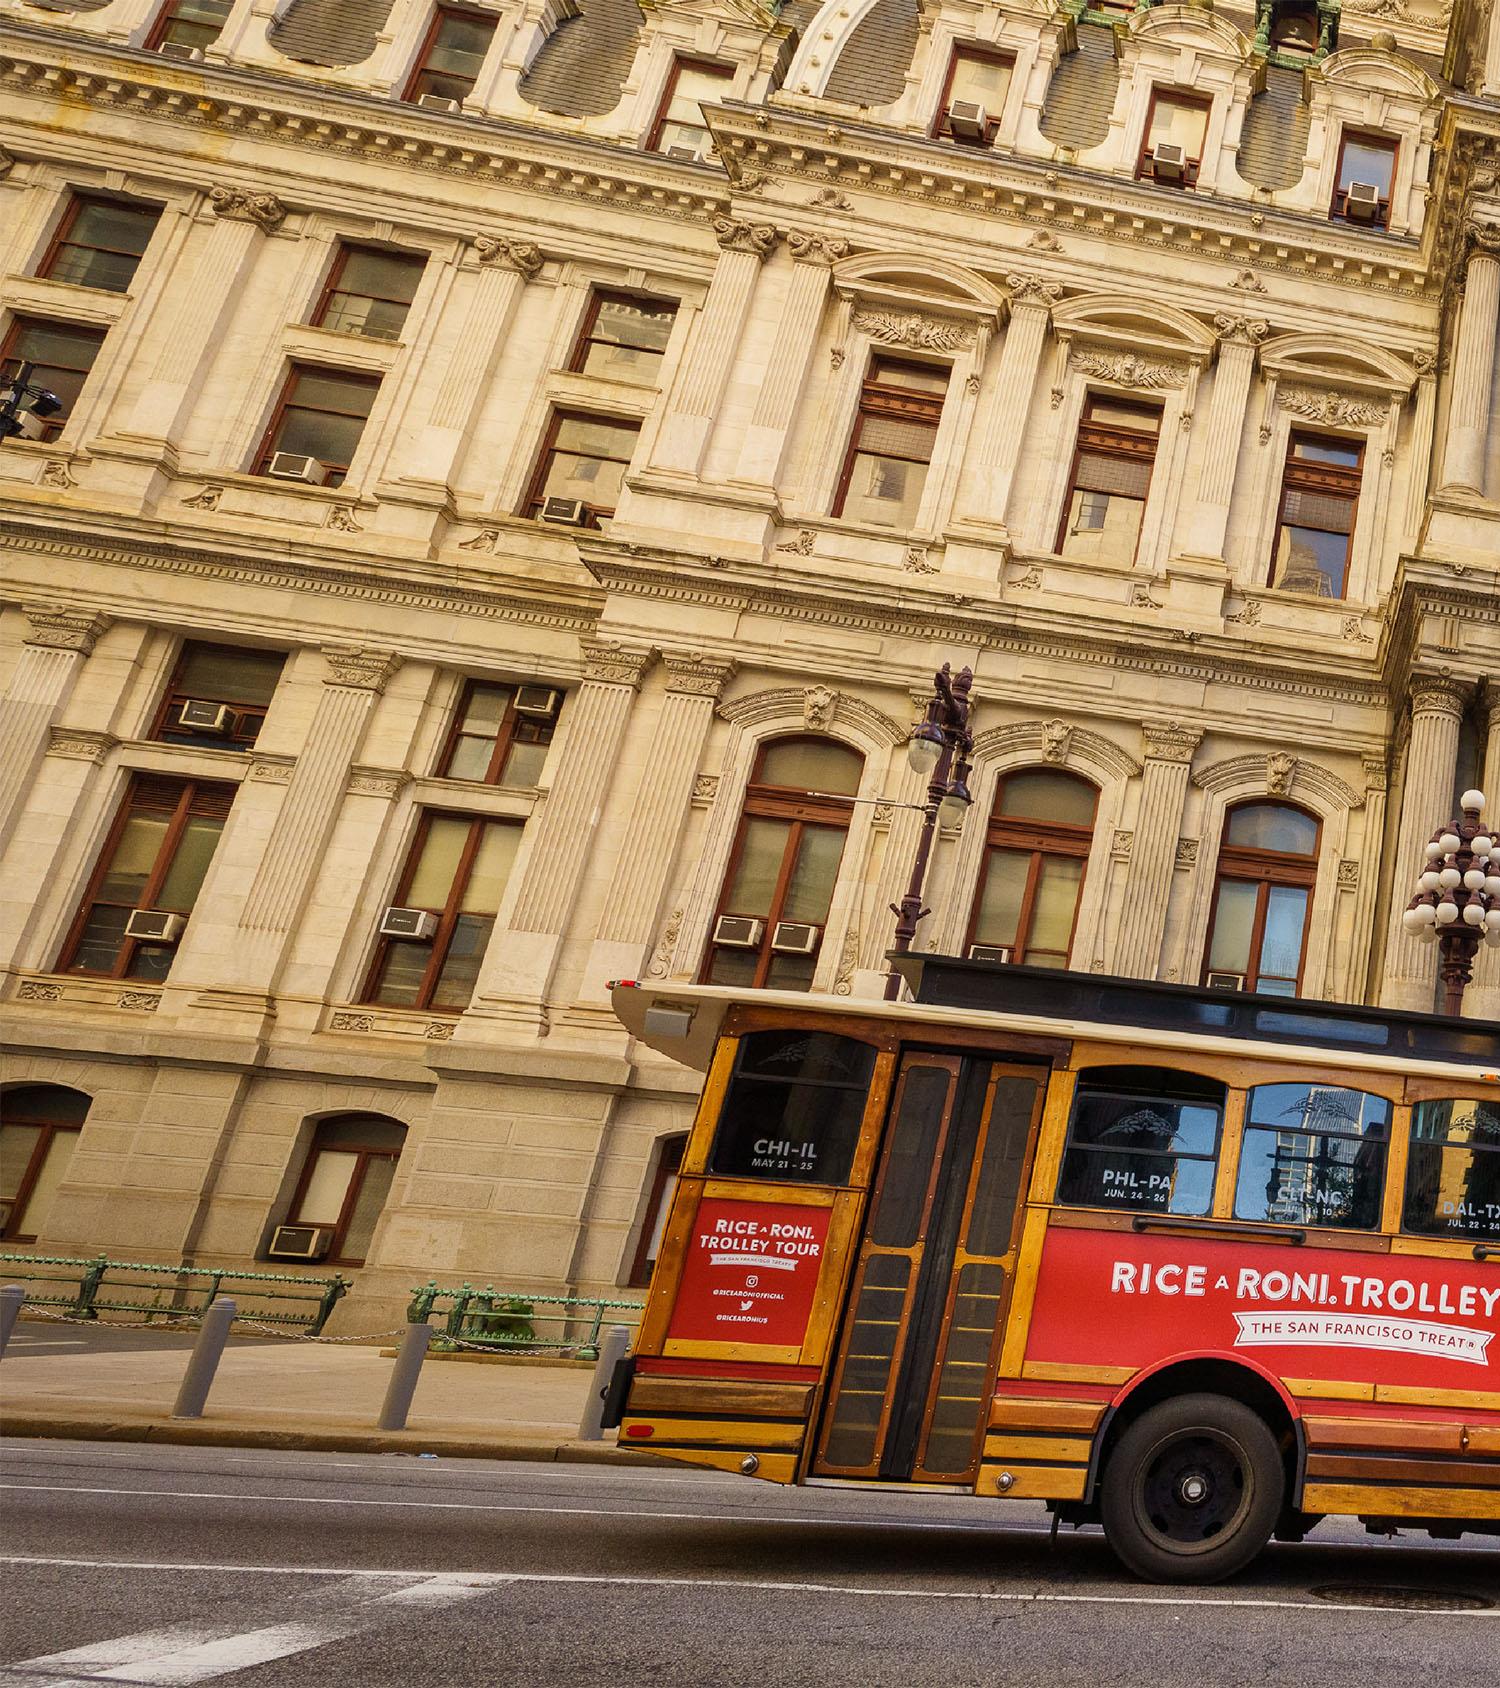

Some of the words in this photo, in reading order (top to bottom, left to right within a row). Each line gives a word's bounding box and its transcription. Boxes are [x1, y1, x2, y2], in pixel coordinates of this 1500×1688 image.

[753, 1139, 818, 1159] CHI-IL
[751, 1158, 776, 1168] MAY
[777, 1160, 789, 1169] 21
[800, 1162, 813, 1170] 25
[1102, 1169, 1171, 1190] PHL-PA
[1104, 1188, 1128, 1199] JUN.
[1153, 1193, 1166, 1203] 26
[715, 1218, 759, 1236] RICE
[1447, 1218, 1466, 1229] JUL.
[1468, 1221, 1480, 1229] 22
[1489, 1222, 1500, 1231] 24
[700, 1234, 770, 1254] TROLLEY
[775, 1241, 821, 1257] TOUR
[1111, 1261, 1208, 1297] RICE
[1214, 1275, 1229, 1290] A
[1251, 1322, 1283, 1335] THE
[1287, 1322, 1320, 1335] SAN
[1325, 1322, 1413, 1341] FRANCISCO
